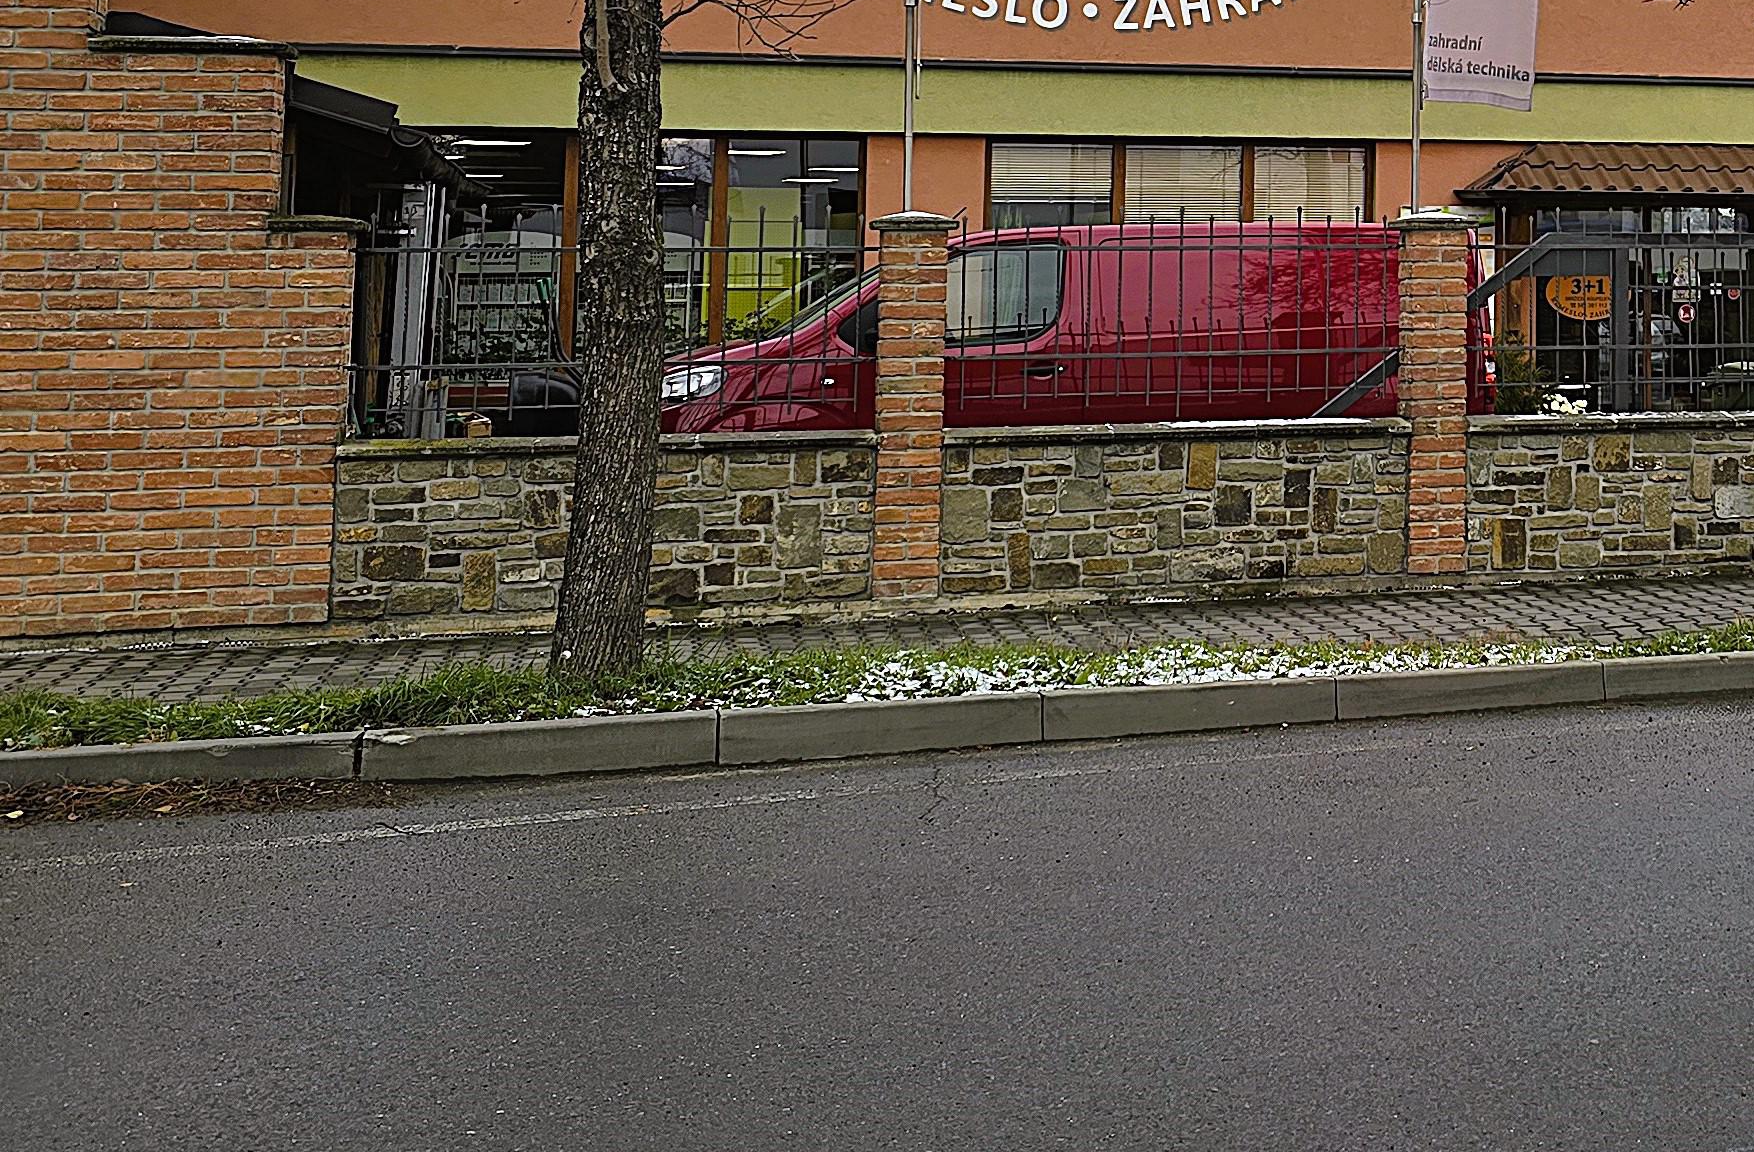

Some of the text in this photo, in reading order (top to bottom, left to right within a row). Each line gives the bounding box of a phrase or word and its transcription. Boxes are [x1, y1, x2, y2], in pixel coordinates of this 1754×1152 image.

[1428, 32, 1484, 51] zahradní
[1466, 60, 1531, 82] technika
[1570, 278, 1606, 295] 3+1
